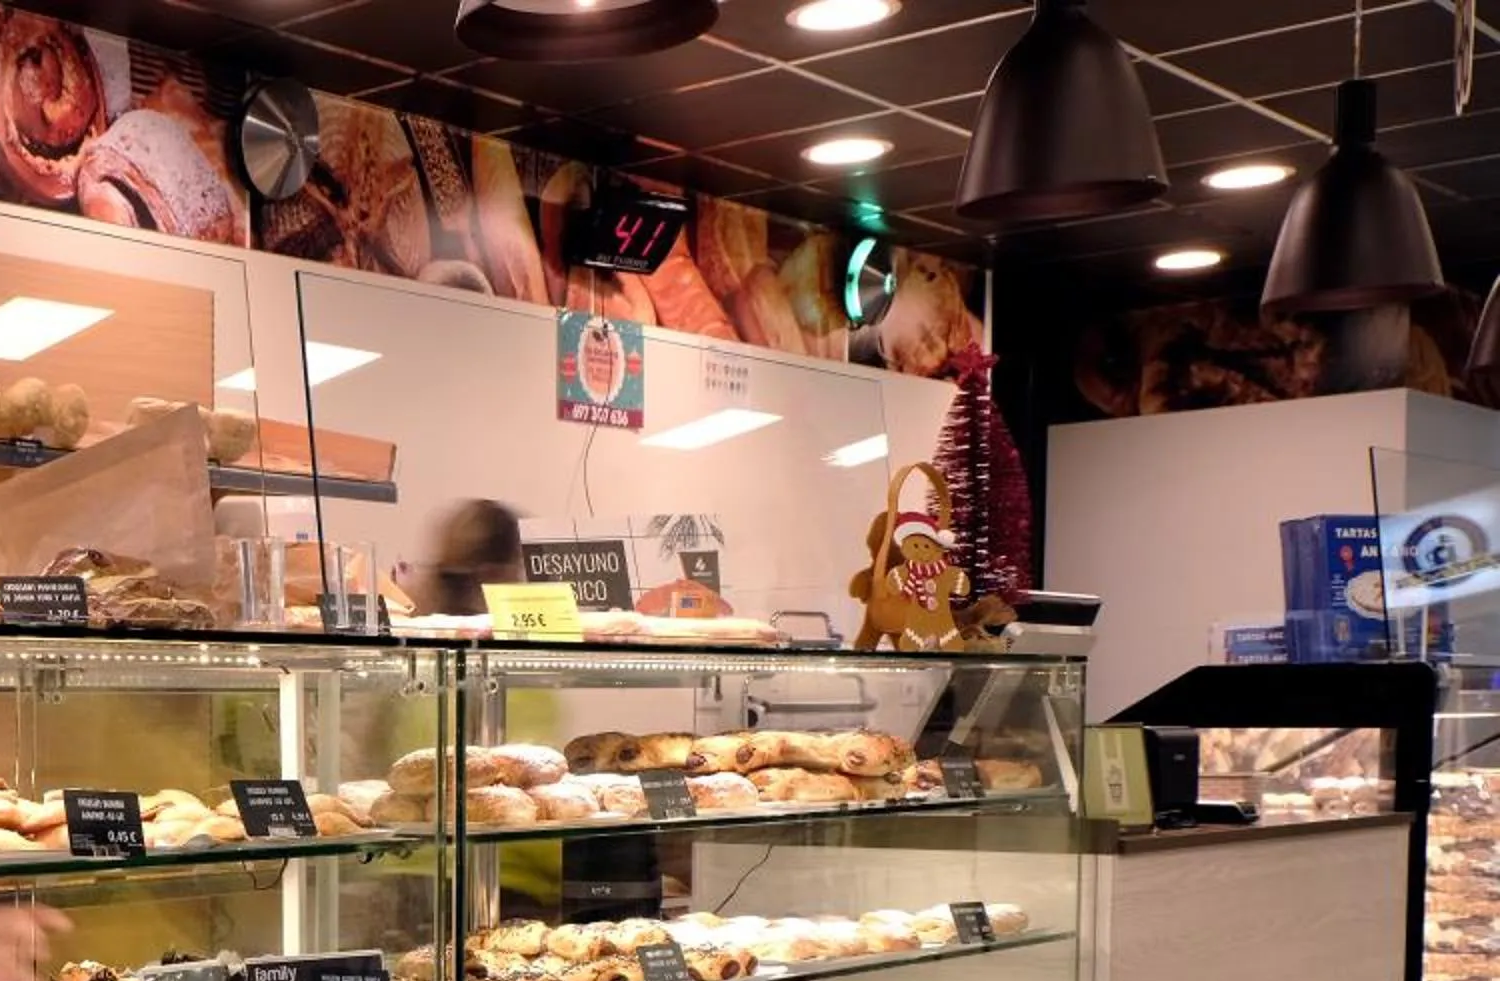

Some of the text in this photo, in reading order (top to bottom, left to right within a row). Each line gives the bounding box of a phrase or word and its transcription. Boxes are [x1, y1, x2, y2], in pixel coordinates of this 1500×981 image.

[615, 214, 666, 257] 41
[1335, 528, 1378, 538] TARTAS
[530, 552, 619, 575] DESAYUNO
